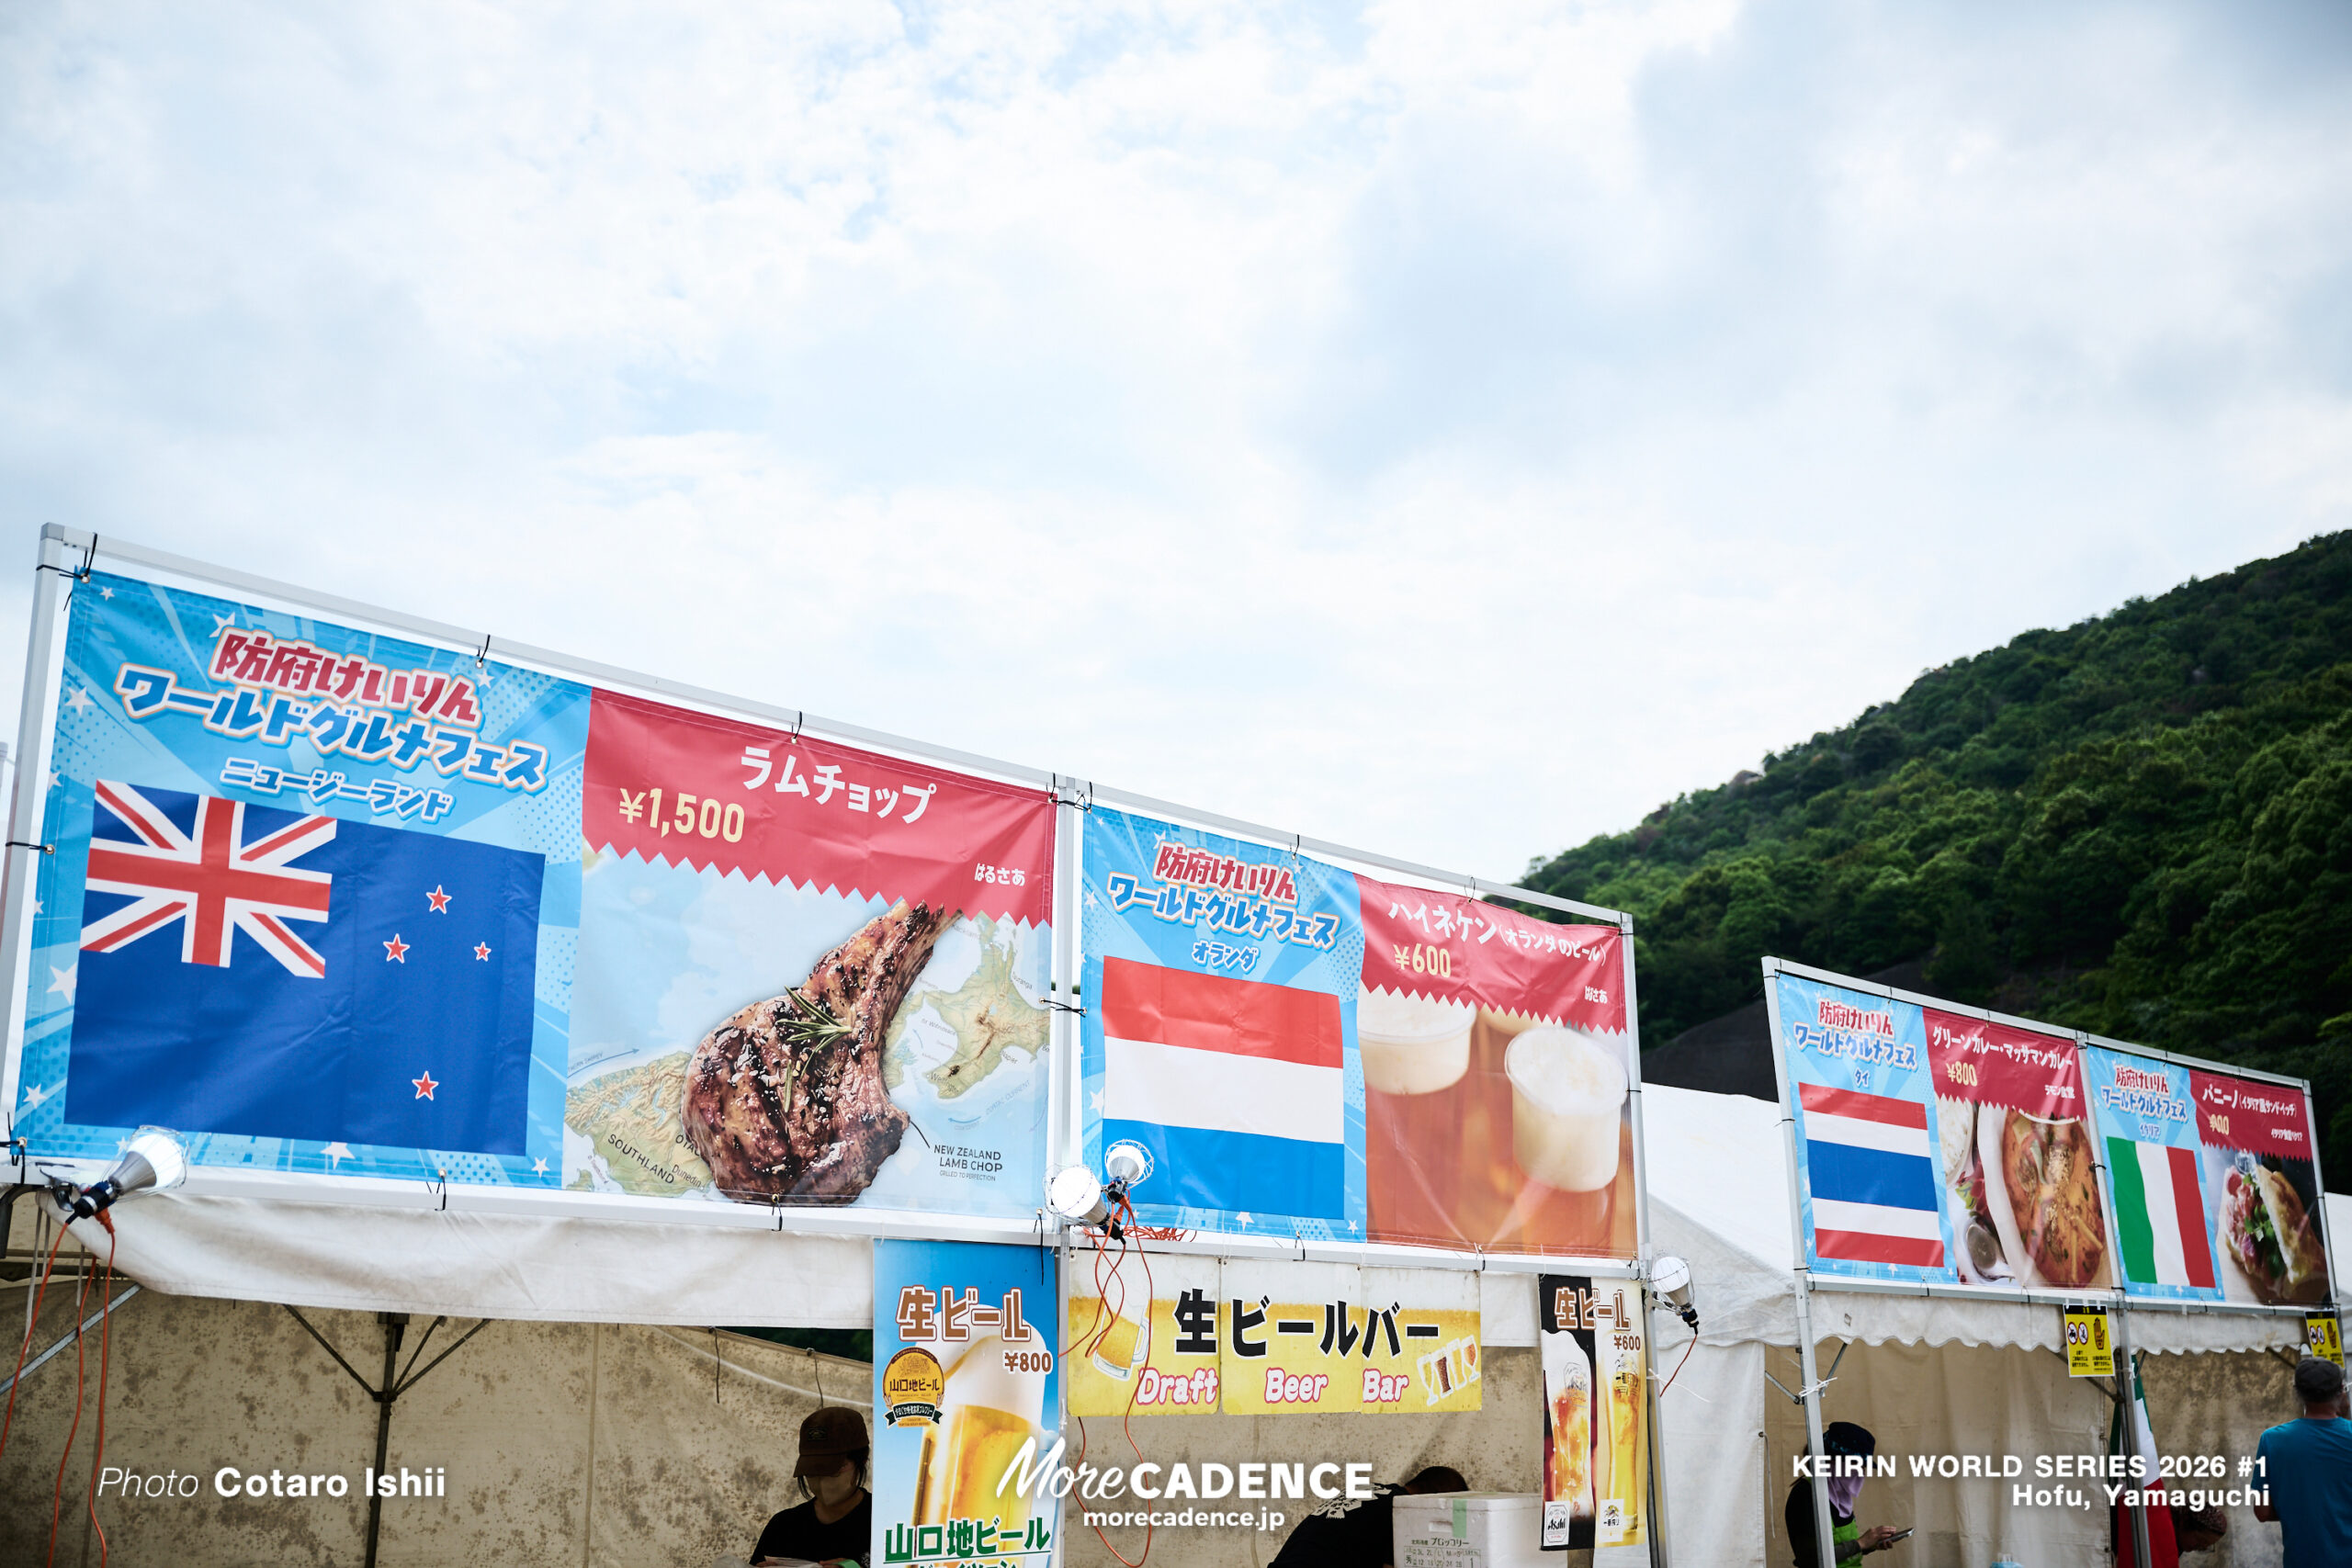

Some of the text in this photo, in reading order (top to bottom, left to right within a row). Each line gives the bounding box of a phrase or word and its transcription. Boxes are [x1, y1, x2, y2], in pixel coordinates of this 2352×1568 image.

[211, 629, 481, 723] 防府けいりん
[117, 665, 548, 788] ワールドグルメフェス
[221, 759, 455, 820] ニュージーランド
[741, 745, 937, 825] ラムチョップ
[619, 787, 745, 843] ¥1,500
[974, 863, 1026, 887] はるさあ
[1155, 844, 1297, 902] 防府けいりん
[1109, 874, 1340, 947] ワールドグルメフェス
[1193, 942, 1260, 973] オランダ
[1393, 942, 1452, 978] ¥600
[1819, 999, 1894, 1036] 防府けいりん
[1794, 1023, 1917, 1069] ワールドグルメフェス
[1933, 1026, 2073, 1070] グリーンカレー・マッサマンカレー
[1855, 1068, 1870, 1085] タイ
[1946, 1061, 1978, 1087] ¥800
[2115, 1066, 2169, 1094] 防府けいりん
[607, 1134, 675, 1184] SOUTHLAND
[933, 1145, 1001, 1160] NEW ZEALAND
[939, 1156, 1003, 1172] LAMB CHOP
[673, 1164, 703, 1188] Dunedin
[966, 1172, 996, 1181] PERFECTION
[897, 1285, 1031, 1342] 生ビール
[1173, 1288, 1441, 1359] 生ビールバー
[1555, 1287, 1631, 1331] 生ビール
[1003, 1351, 1053, 1372] ¥800
[1613, 1335, 1641, 1351] ¥600
[889, 1378, 940, 1392] 山口地ビール
[1136, 1367, 1409, 1405] Draft Beer Bar
[885, 1517, 1052, 1559] 山口地ビール
[1547, 1518, 1566, 1530] Asahi
